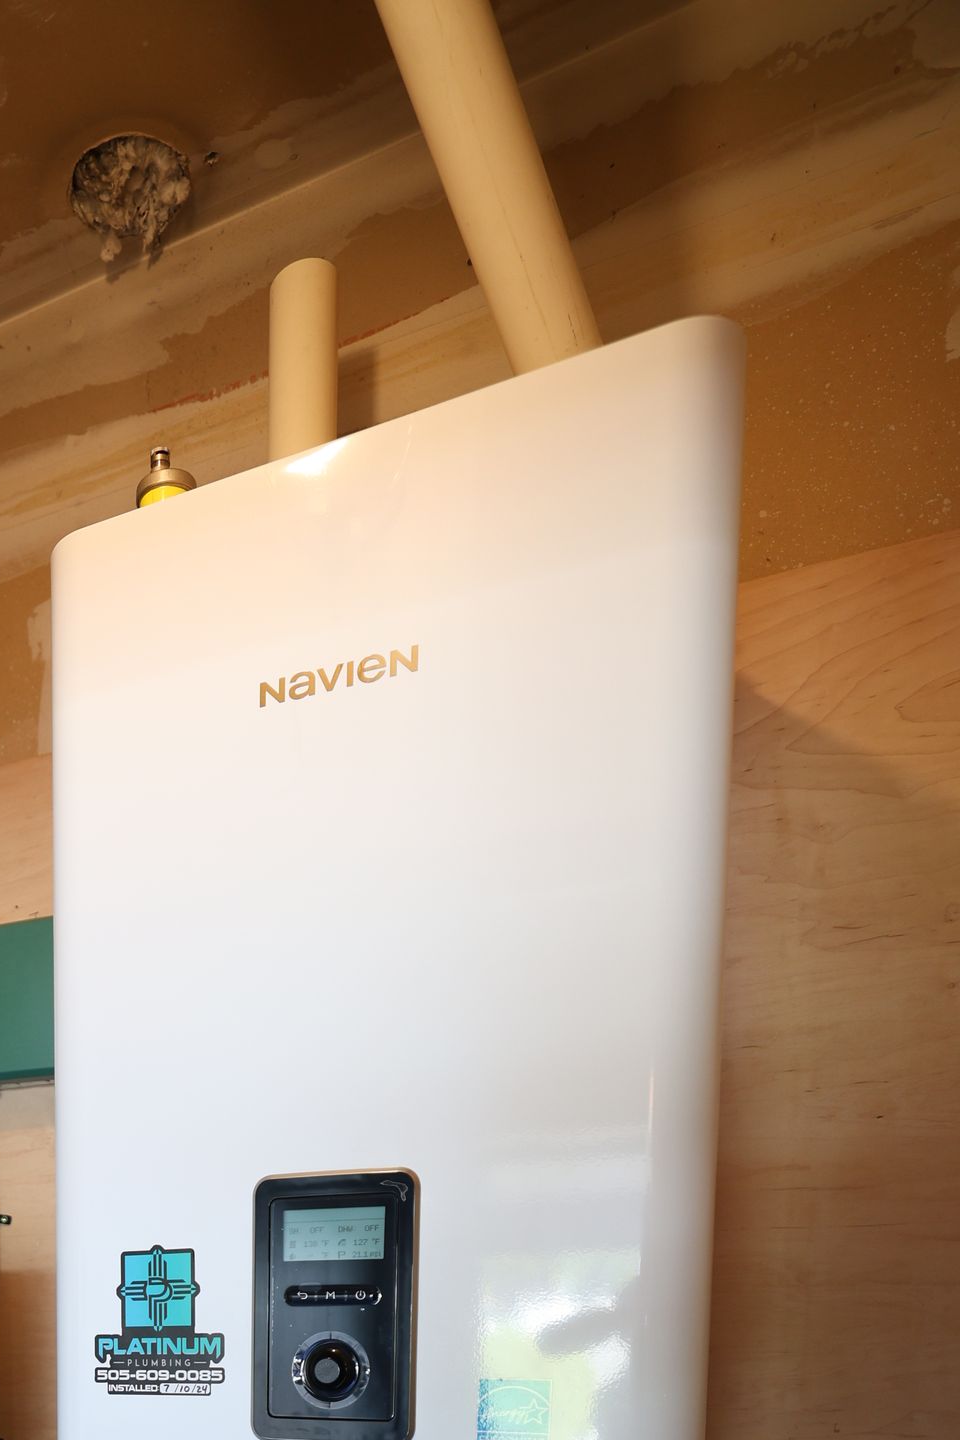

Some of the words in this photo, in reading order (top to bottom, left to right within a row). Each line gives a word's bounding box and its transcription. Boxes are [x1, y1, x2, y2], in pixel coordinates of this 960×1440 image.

[364, 1224, 381, 1232] OFF
[98, 1337, 220, 1359] PLATINUM
[127, 1359, 191, 1367] PLUMBING
[97, 1369, 223, 1381] 505-609-0085
